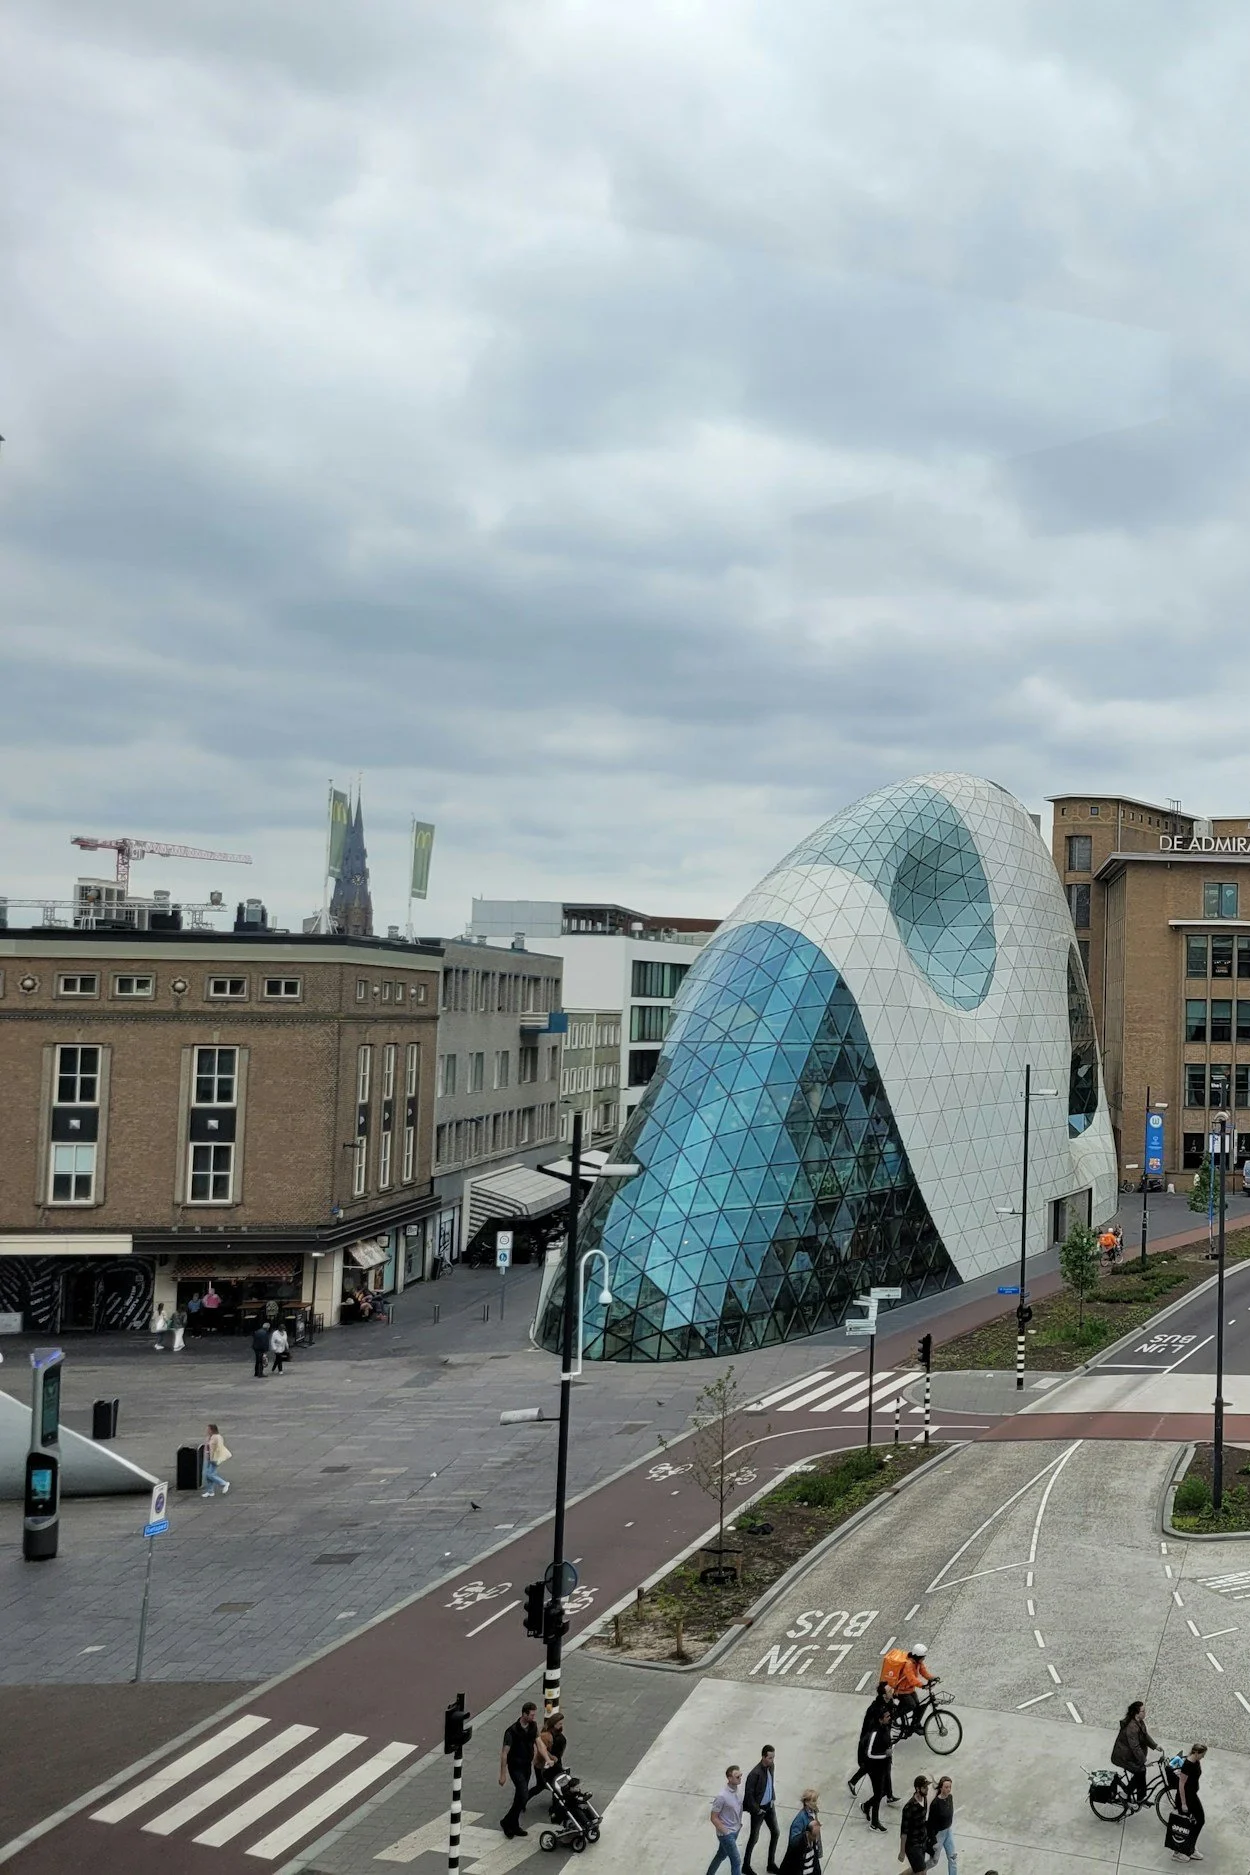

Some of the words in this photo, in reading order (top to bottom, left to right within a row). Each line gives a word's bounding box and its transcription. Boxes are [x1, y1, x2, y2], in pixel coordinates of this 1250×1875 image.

[1160, 836, 1183, 850] DE
[1149, 1335, 1197, 1343] BUS
[1134, 1344, 1184, 1353] LIJN
[786, 1610, 879, 1638] BUS
[748, 1644, 854, 1674] LIJN
